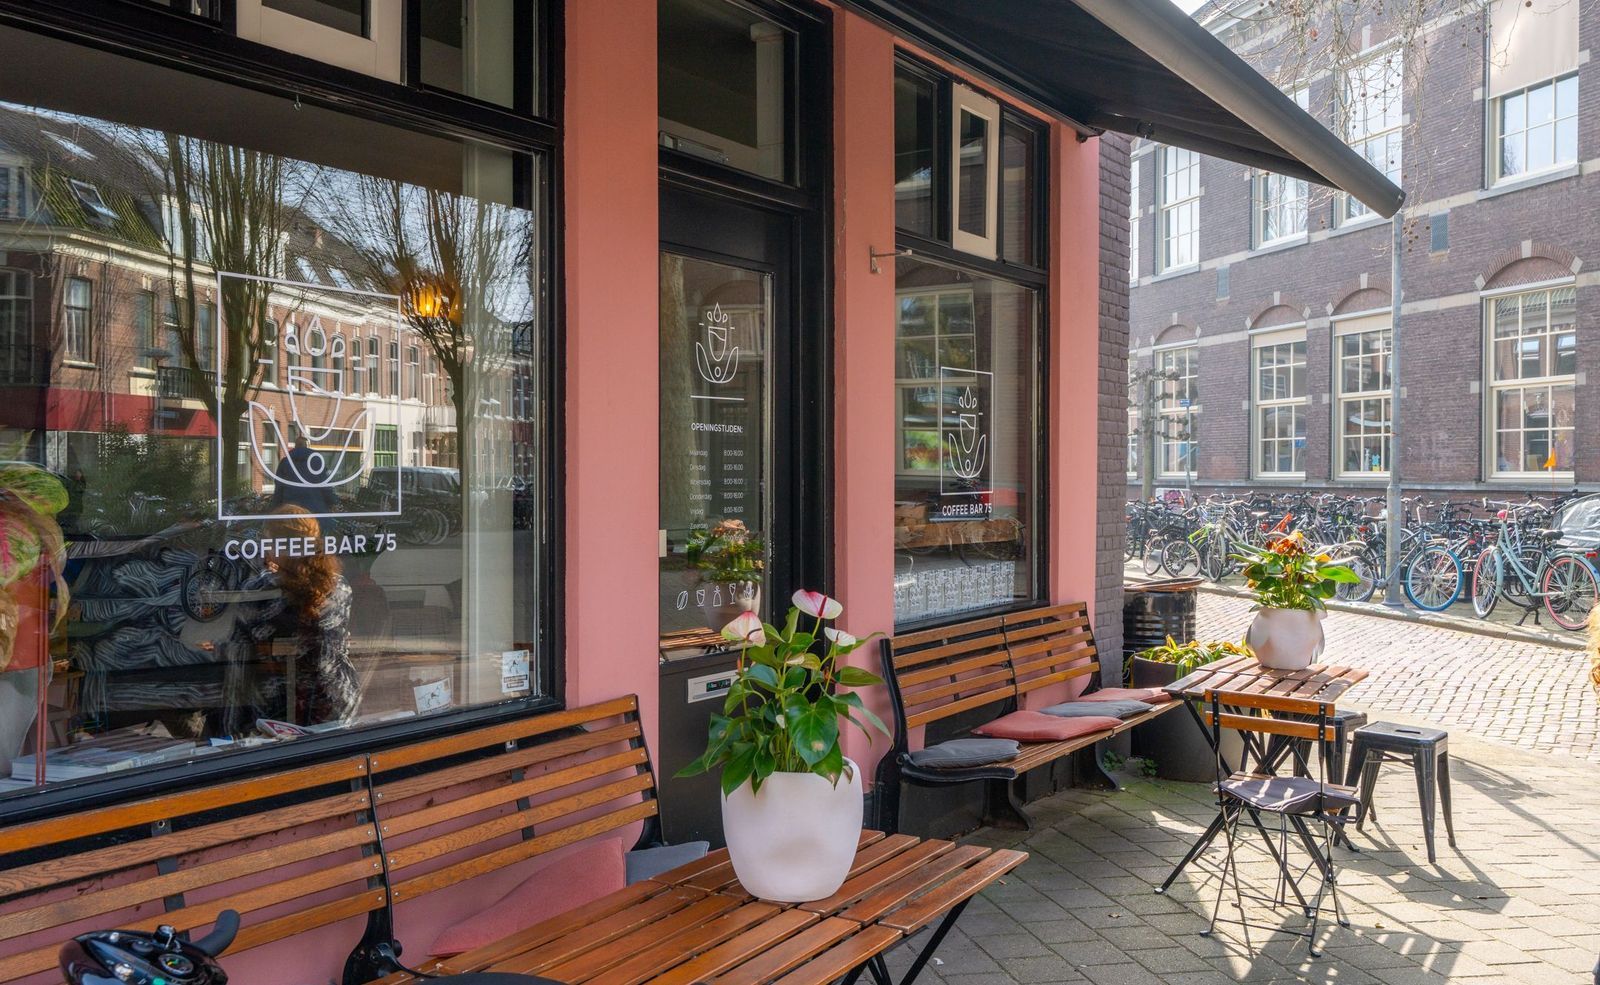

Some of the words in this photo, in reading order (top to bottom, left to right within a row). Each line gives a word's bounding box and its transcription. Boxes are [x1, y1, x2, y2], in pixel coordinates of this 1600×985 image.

[691, 422, 743, 433] OPENINGSTIJDEN:
[942, 504, 969, 516] COFFEE
[969, 503, 984, 514] BAR
[984, 503, 993, 513] 75
[224, 536, 316, 561] COFFEE
[324, 534, 367, 555] BAR
[374, 533, 397, 552] 75
